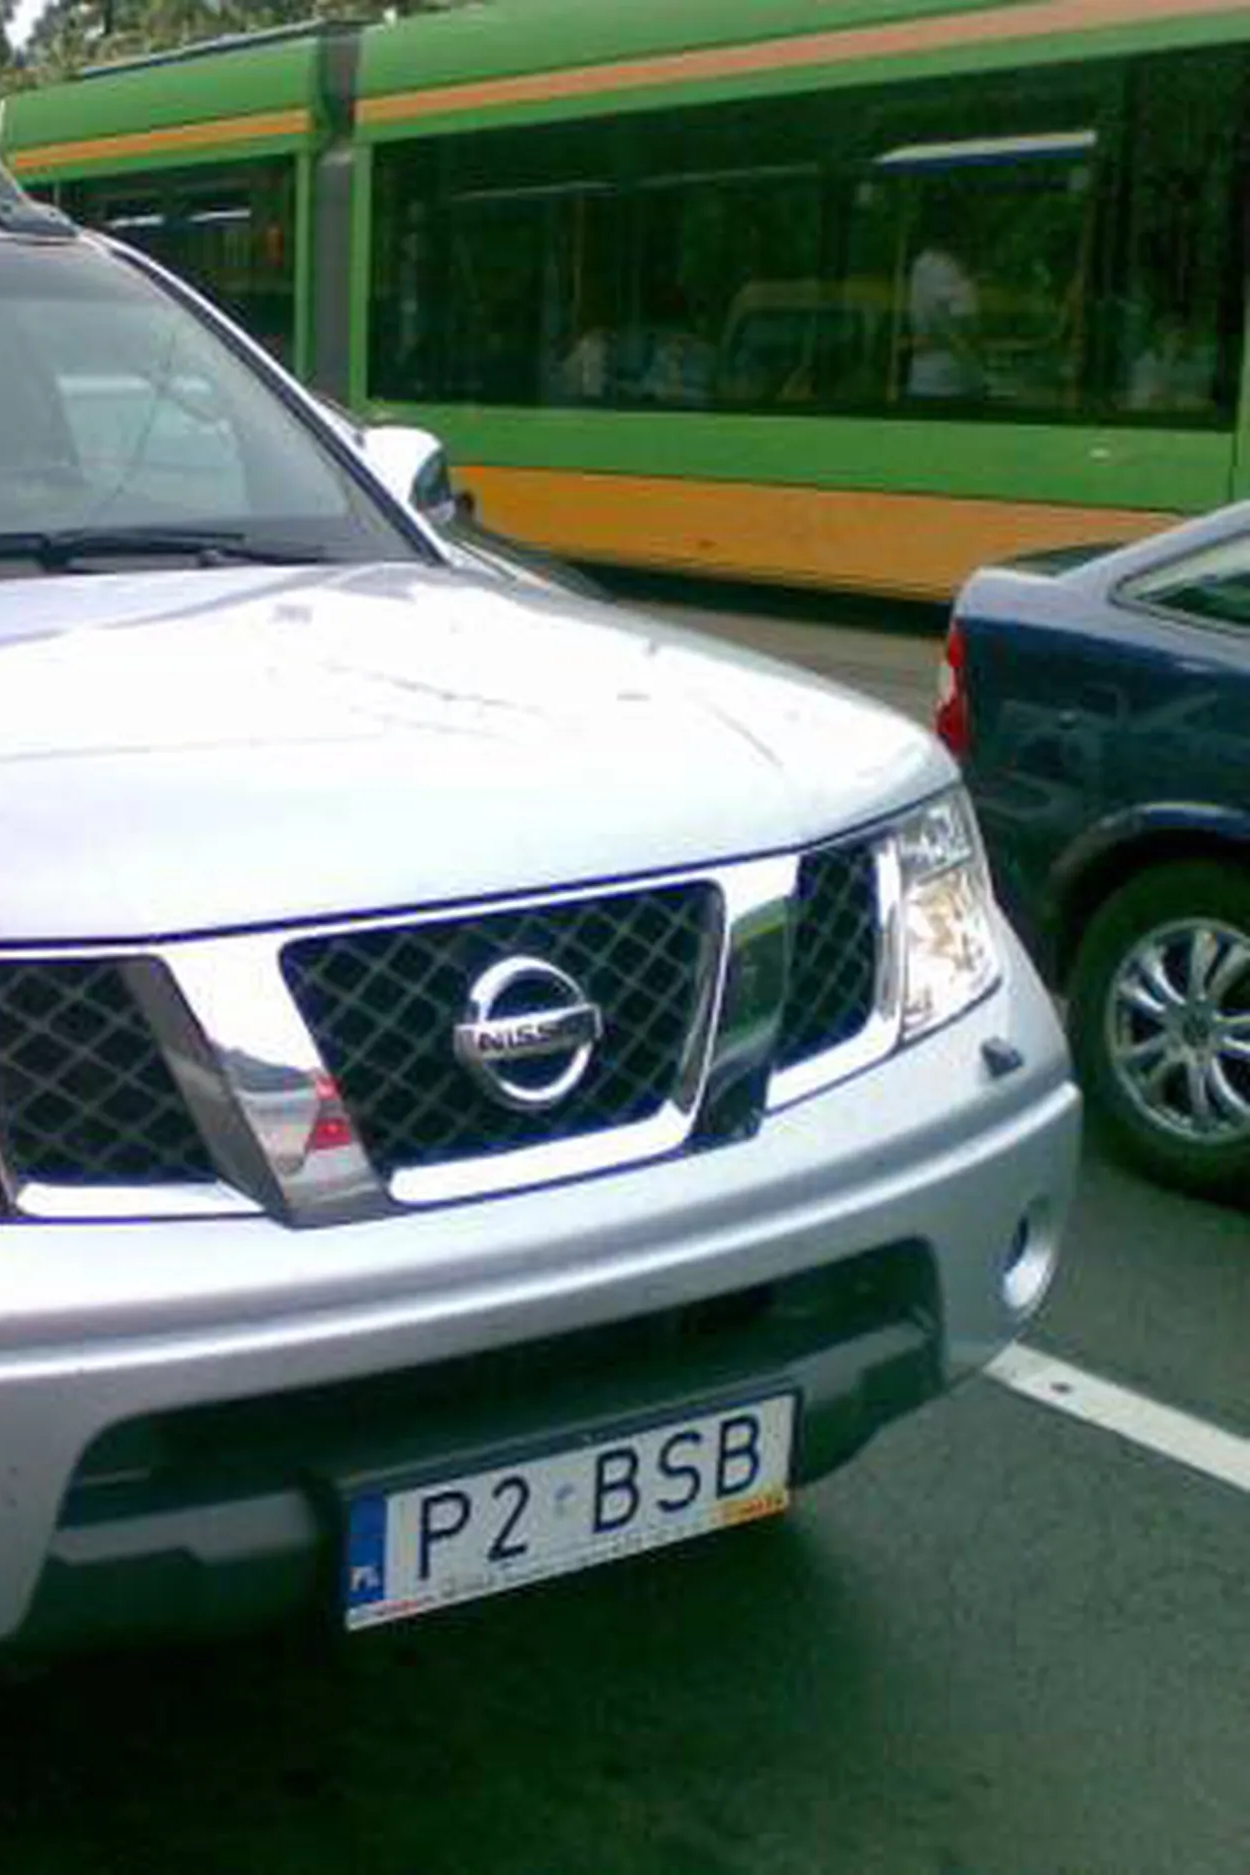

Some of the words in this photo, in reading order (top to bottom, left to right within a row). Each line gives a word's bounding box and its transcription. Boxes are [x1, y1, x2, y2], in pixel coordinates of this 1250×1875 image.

[477, 1009, 593, 1052] NISS
[418, 1475, 531, 1581] P2
[592, 1413, 762, 1534] BSB
